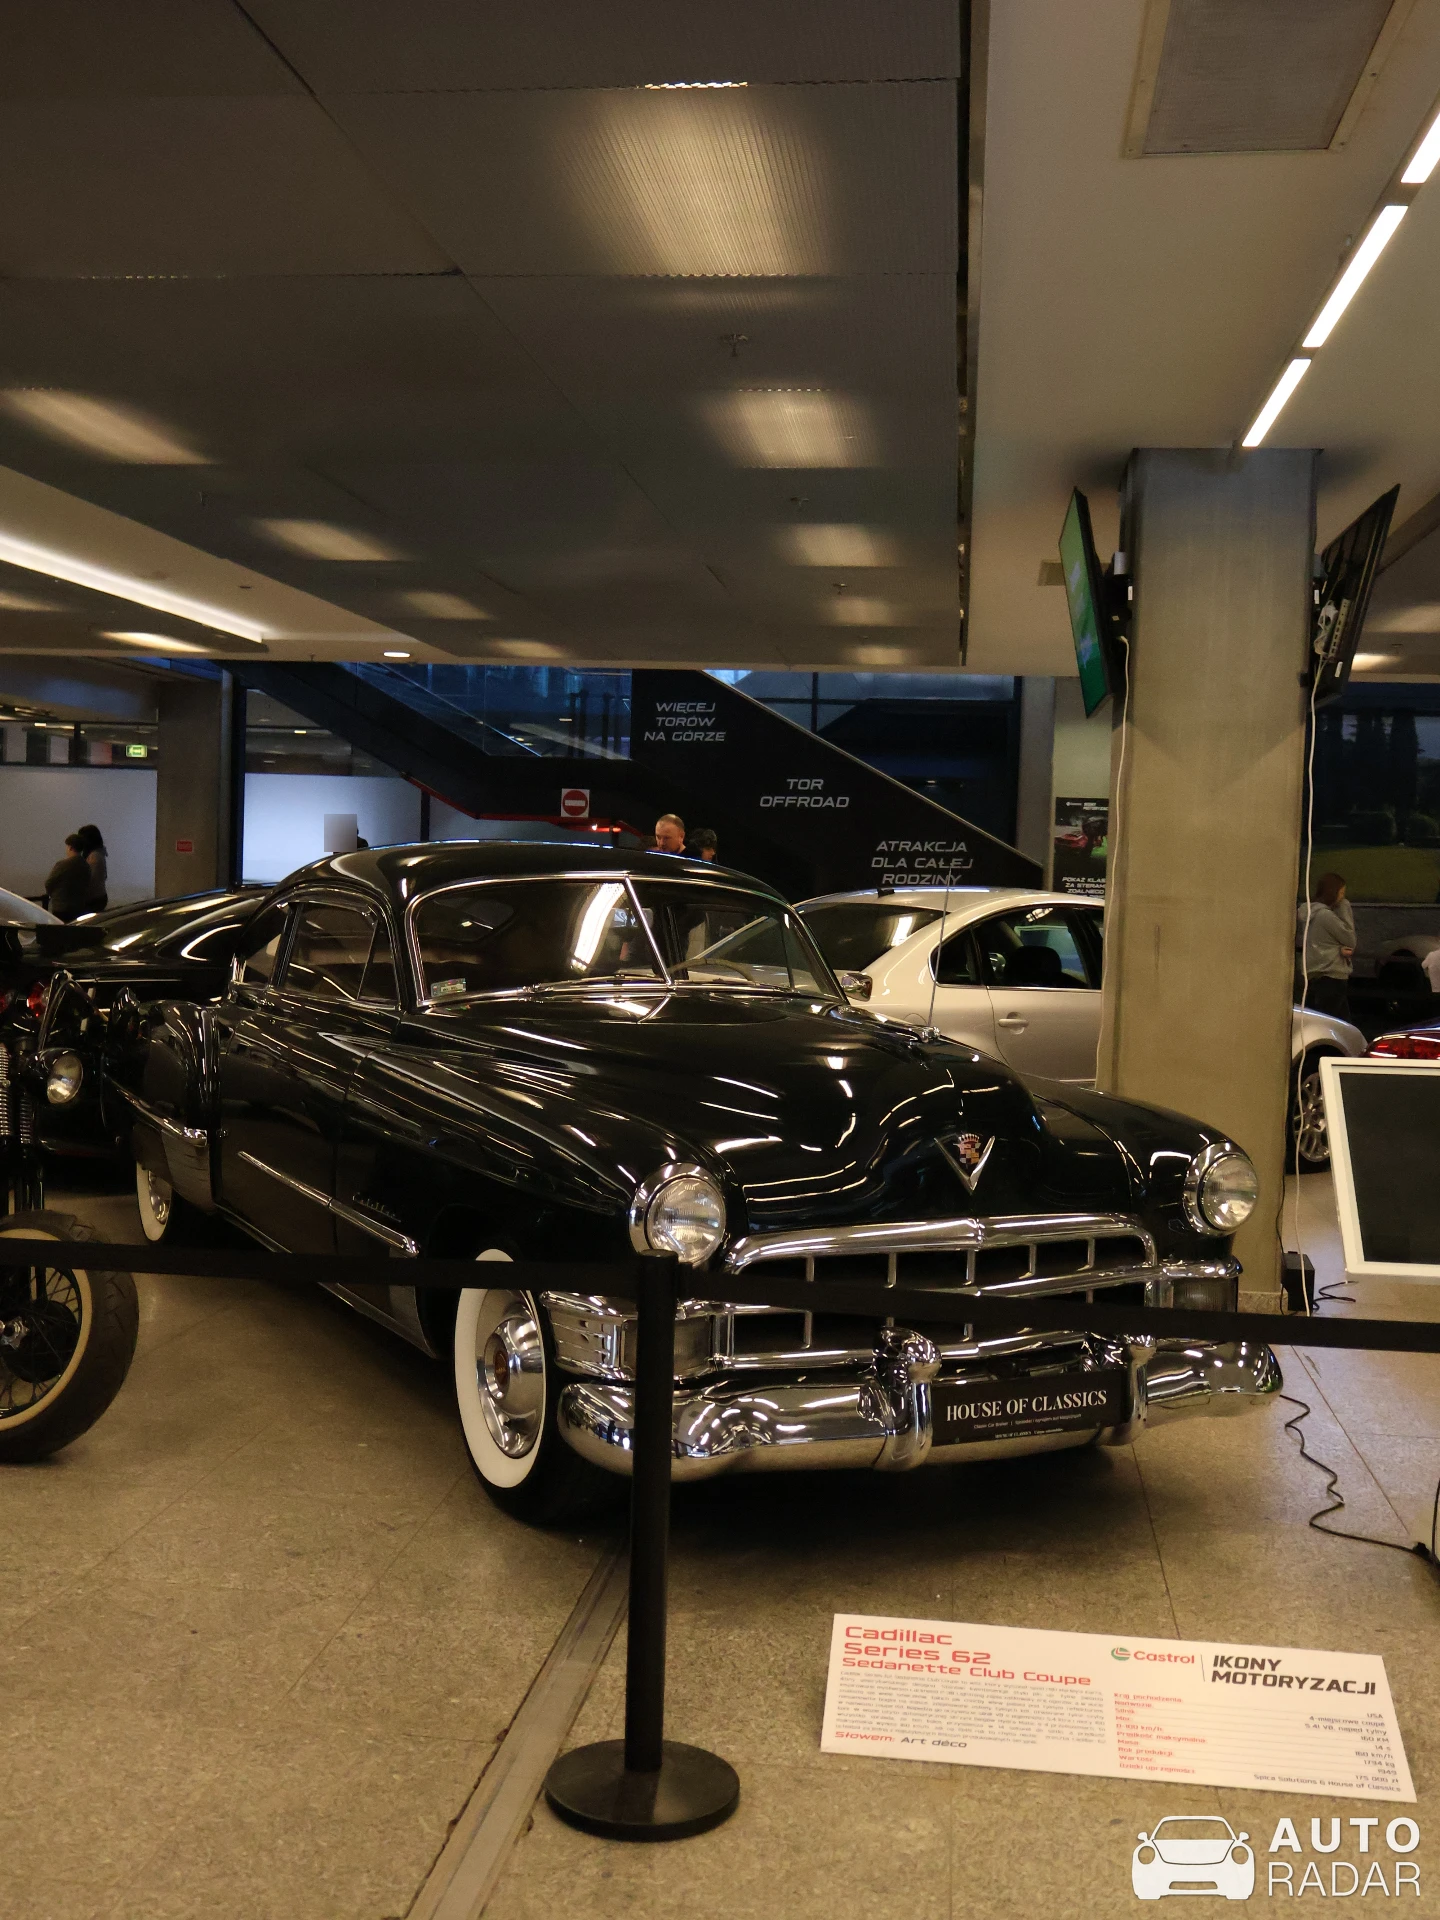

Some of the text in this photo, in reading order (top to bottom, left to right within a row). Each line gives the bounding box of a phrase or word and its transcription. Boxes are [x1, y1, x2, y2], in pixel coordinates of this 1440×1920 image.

[656, 702, 716, 713] WIĘCEJ
[656, 716, 716, 727] TORÓW
[644, 730, 726, 741] NA GÓRZE
[786, 779, 824, 790] TOR
[760, 796, 850, 808] OFFROAD
[876, 841, 968, 852] ATRAKCJA
[871, 857, 974, 869] DLA CAŁEJ
[882, 873, 962, 885] RODZINY
[946, 1400, 1002, 1422] HOUSE
[1006, 1398, 1029, 1415] OF
[1031, 1390, 1107, 1413] CLASSICS
[845, 1626, 953, 1645] Cadillac
[844, 1642, 991, 1665] Series 62
[1133, 1651, 1195, 1664] Castrol
[1213, 1655, 1282, 1672] IKONY
[842, 1657, 1091, 1686] Sedanette Club Coupe
[1211, 1671, 1376, 1696] MOTORYZACJI
[901, 1736, 927, 1744] Art
